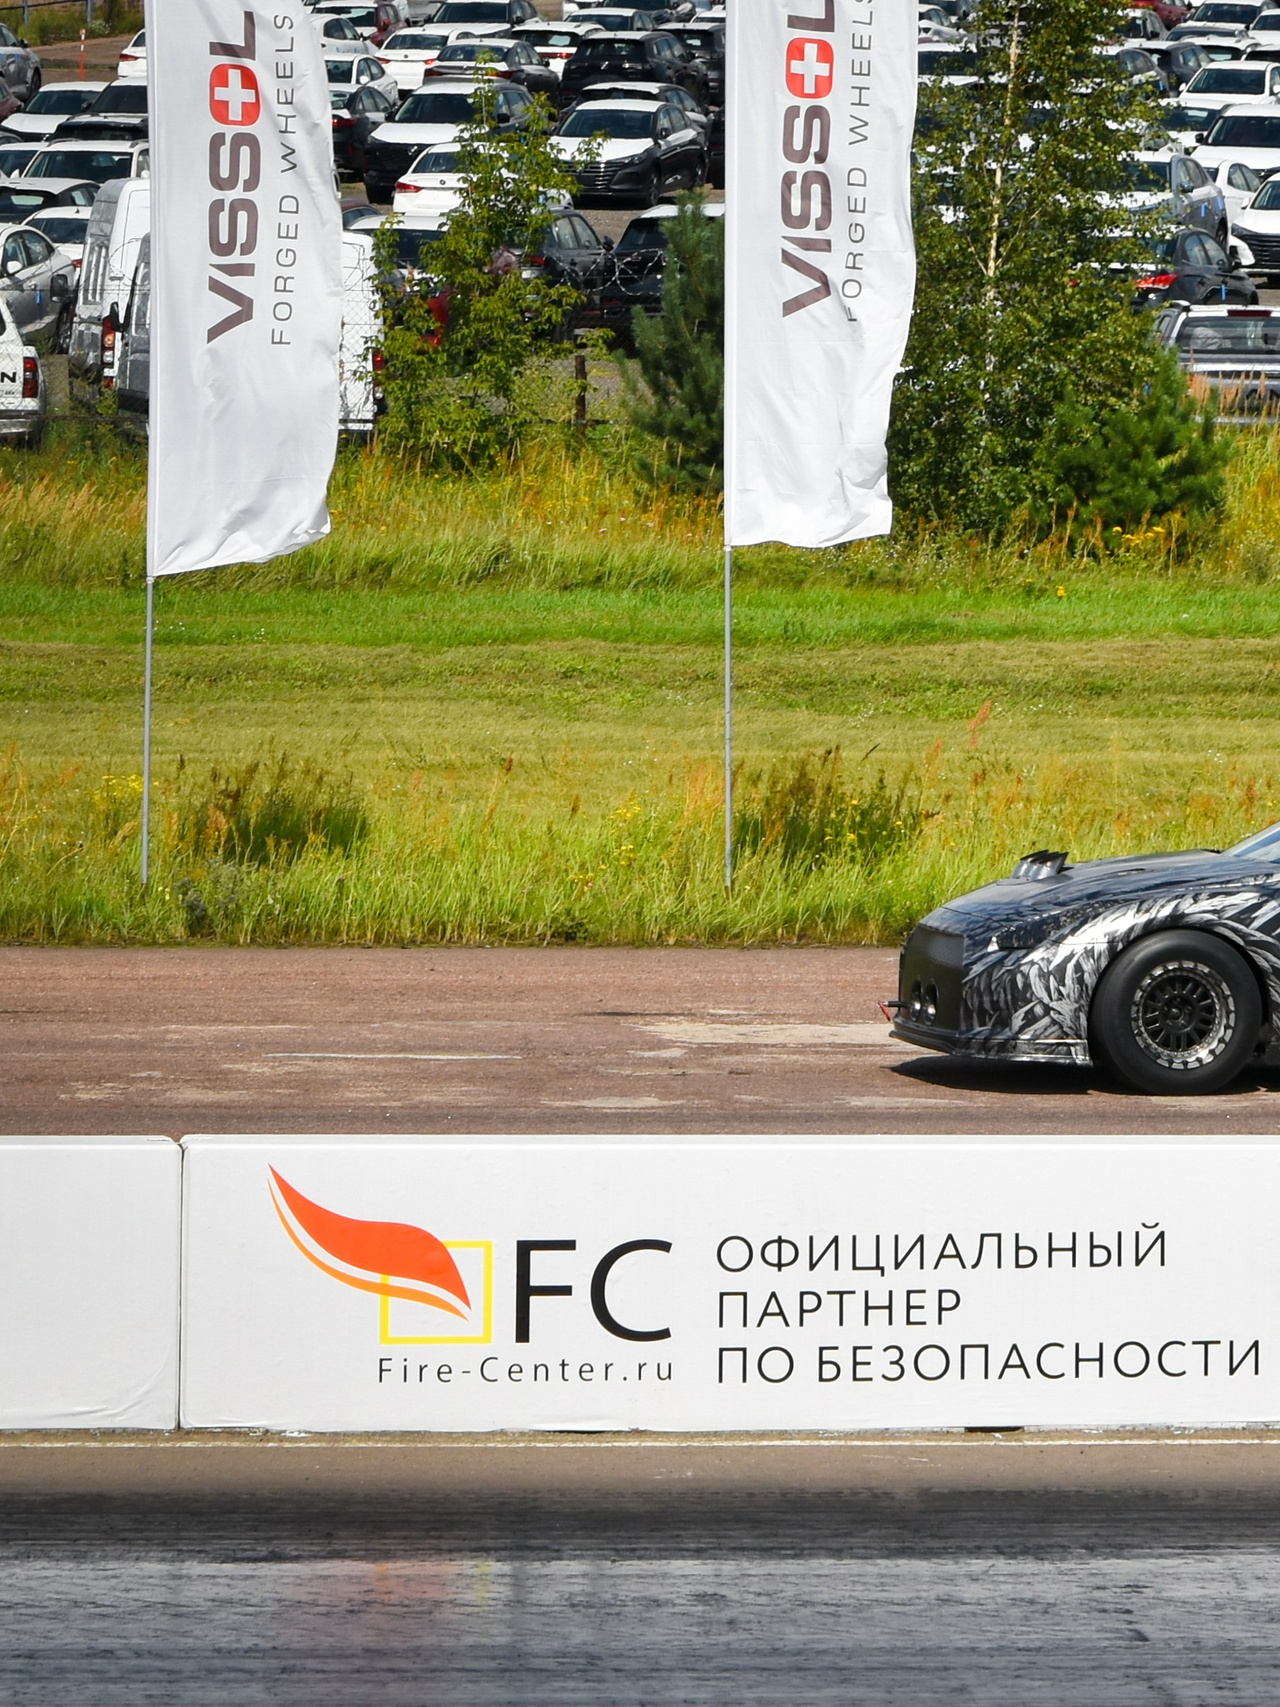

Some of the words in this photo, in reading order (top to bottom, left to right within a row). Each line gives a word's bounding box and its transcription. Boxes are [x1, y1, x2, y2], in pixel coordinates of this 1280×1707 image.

[273, 14, 298, 174] WHEELS
[271, 195, 300, 346] FORGED
[841, 167, 868, 322] FORGED
[716, 1222, 1167, 1277] ОФИЦИАЛЬНЫЙ
[515, 1238, 673, 1343] FC
[718, 1289, 962, 1328] ПАРТНЕР
[378, 1356, 673, 1384] Fire-Center.ru
[718, 1346, 795, 1384] ПО
[818, 1339, 1261, 1383] БЕЗОПАСНОСТИ
